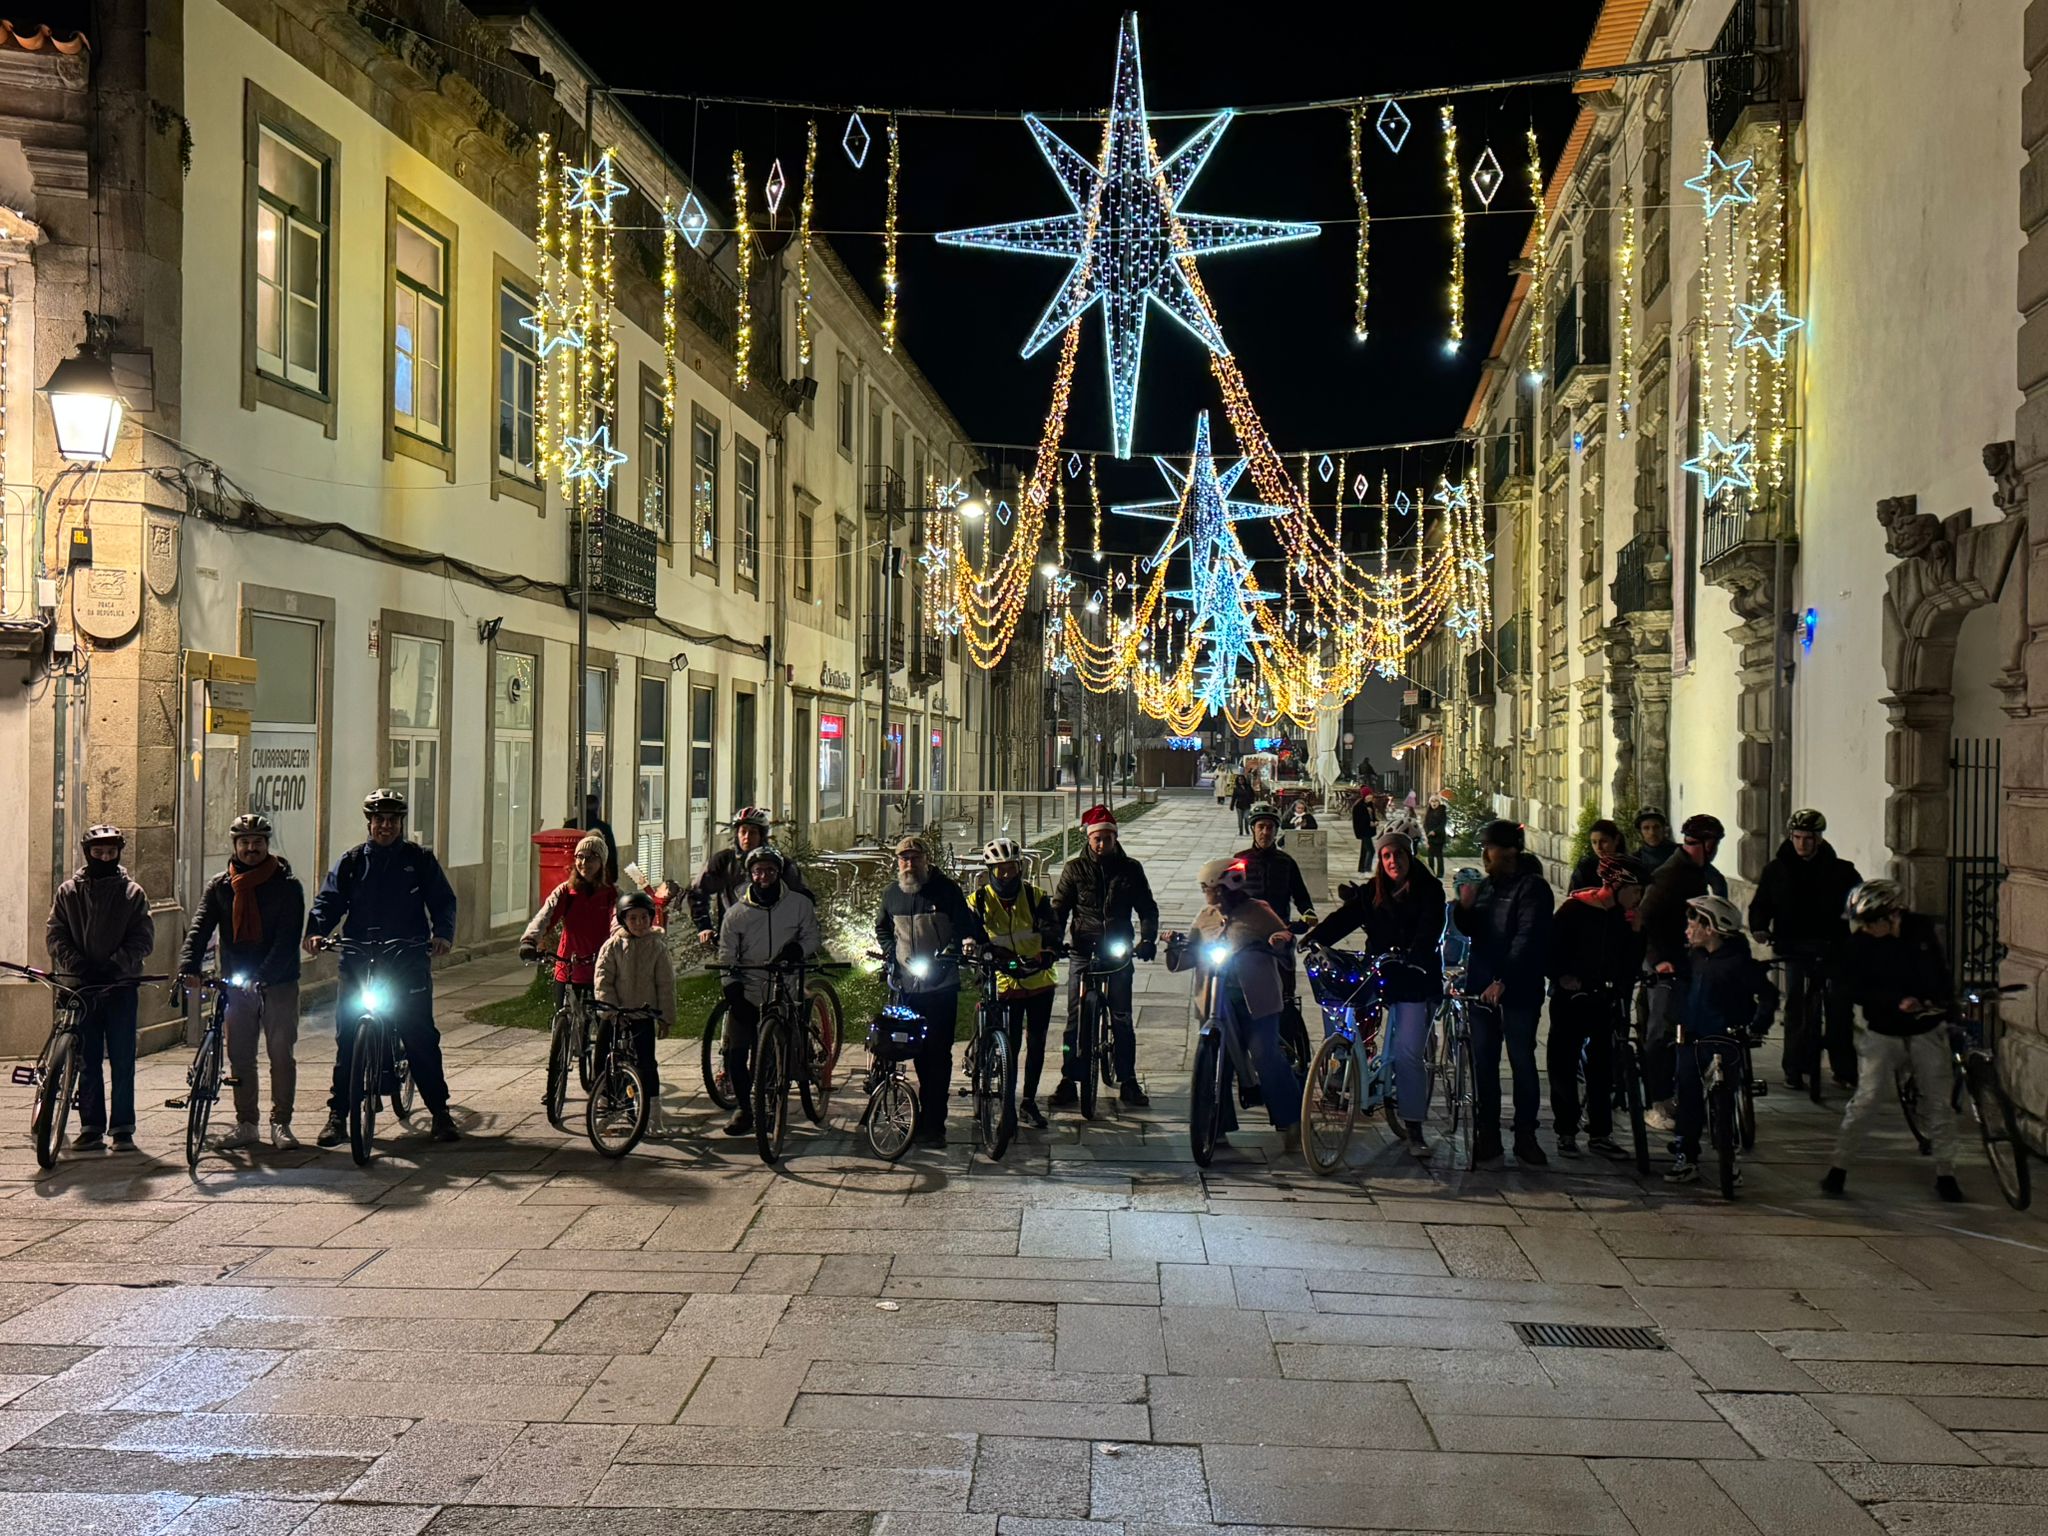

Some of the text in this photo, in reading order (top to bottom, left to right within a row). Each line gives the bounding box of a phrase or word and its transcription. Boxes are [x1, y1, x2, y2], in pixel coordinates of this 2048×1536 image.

[98, 601, 115, 609] PRAÇA
[252, 749, 310, 768] CHURRASQUEIRA
[255, 775, 306, 812] OCEANO
